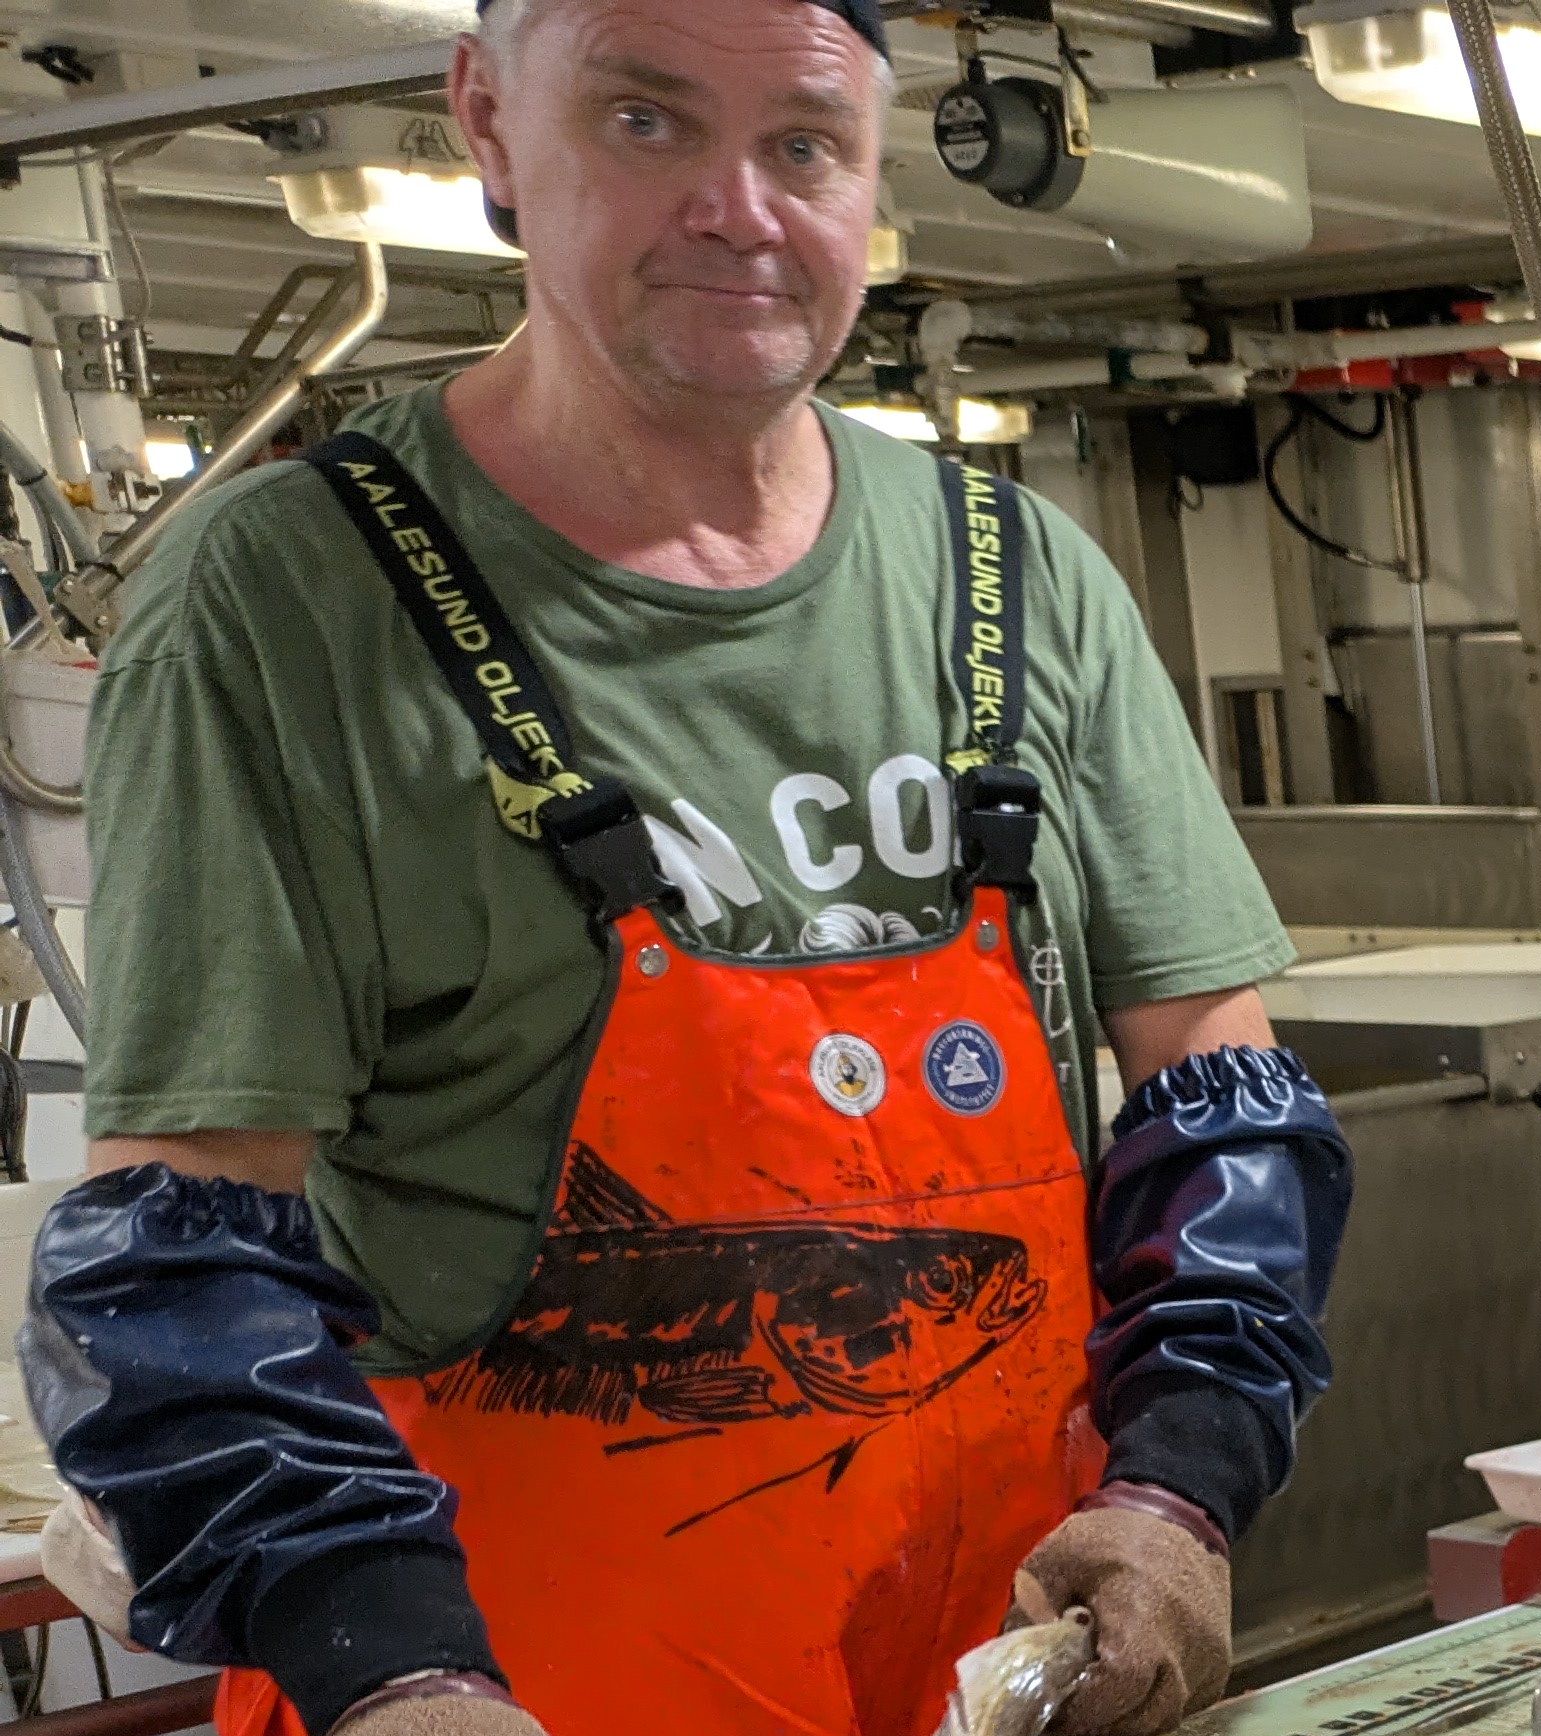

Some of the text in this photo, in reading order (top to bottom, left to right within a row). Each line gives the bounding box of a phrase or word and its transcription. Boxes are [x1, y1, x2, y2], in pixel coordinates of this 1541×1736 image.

[337, 461, 568, 777] AALESUND OLJEK
[961, 464, 1004, 732] AALESUND OLJEKL
[770, 754, 963, 892] CO
